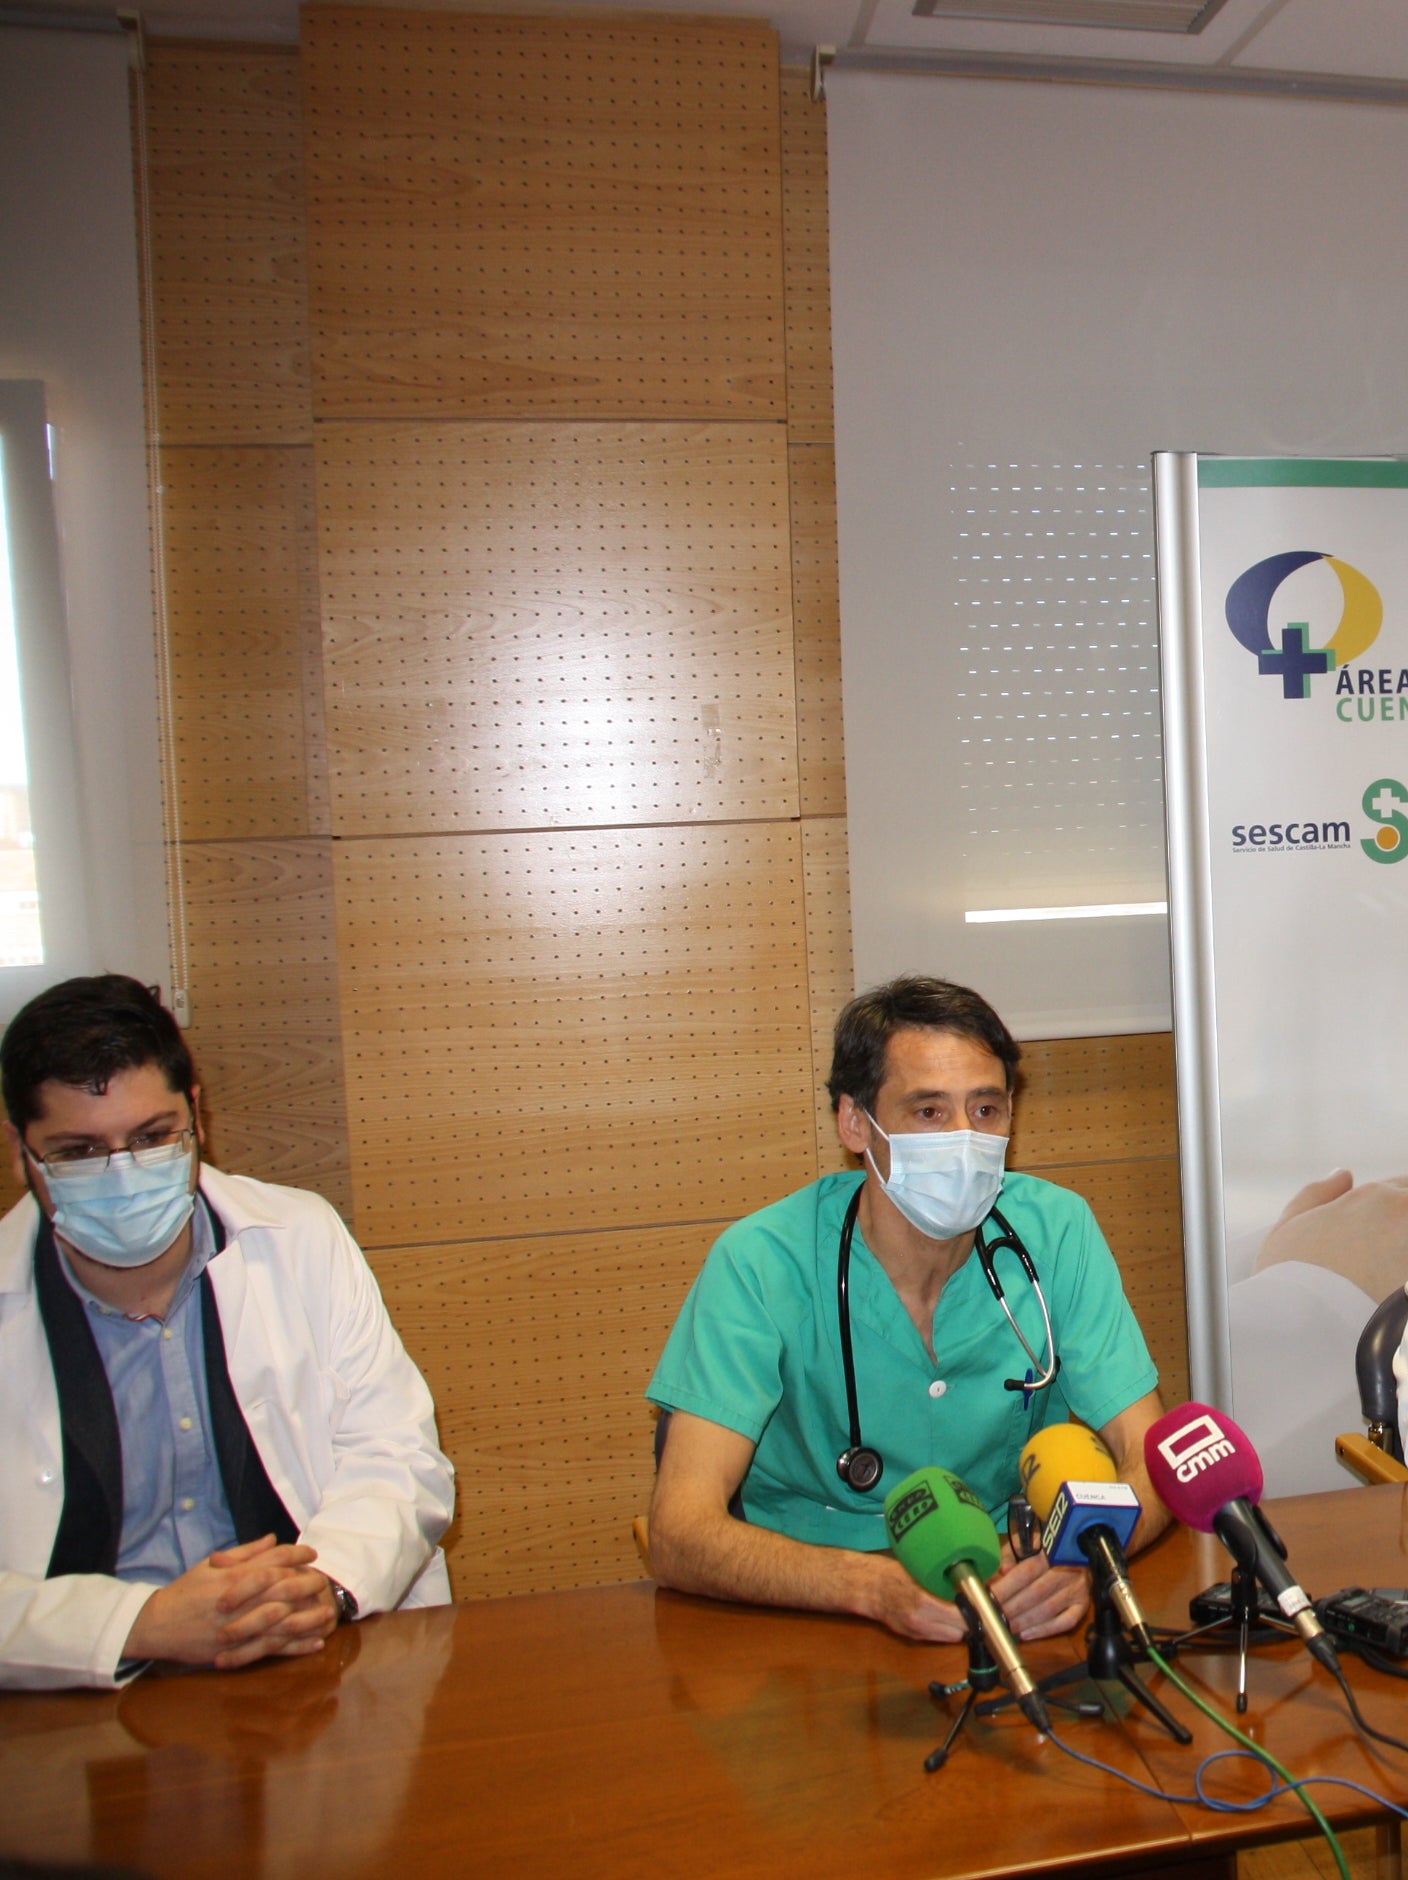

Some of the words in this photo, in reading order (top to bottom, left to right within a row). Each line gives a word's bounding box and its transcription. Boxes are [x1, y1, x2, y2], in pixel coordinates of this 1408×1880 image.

[1231, 821, 1351, 847] sescam
[1294, 843, 1326, 851] Castilla-La
[1042, 1491, 1069, 1556] SER
